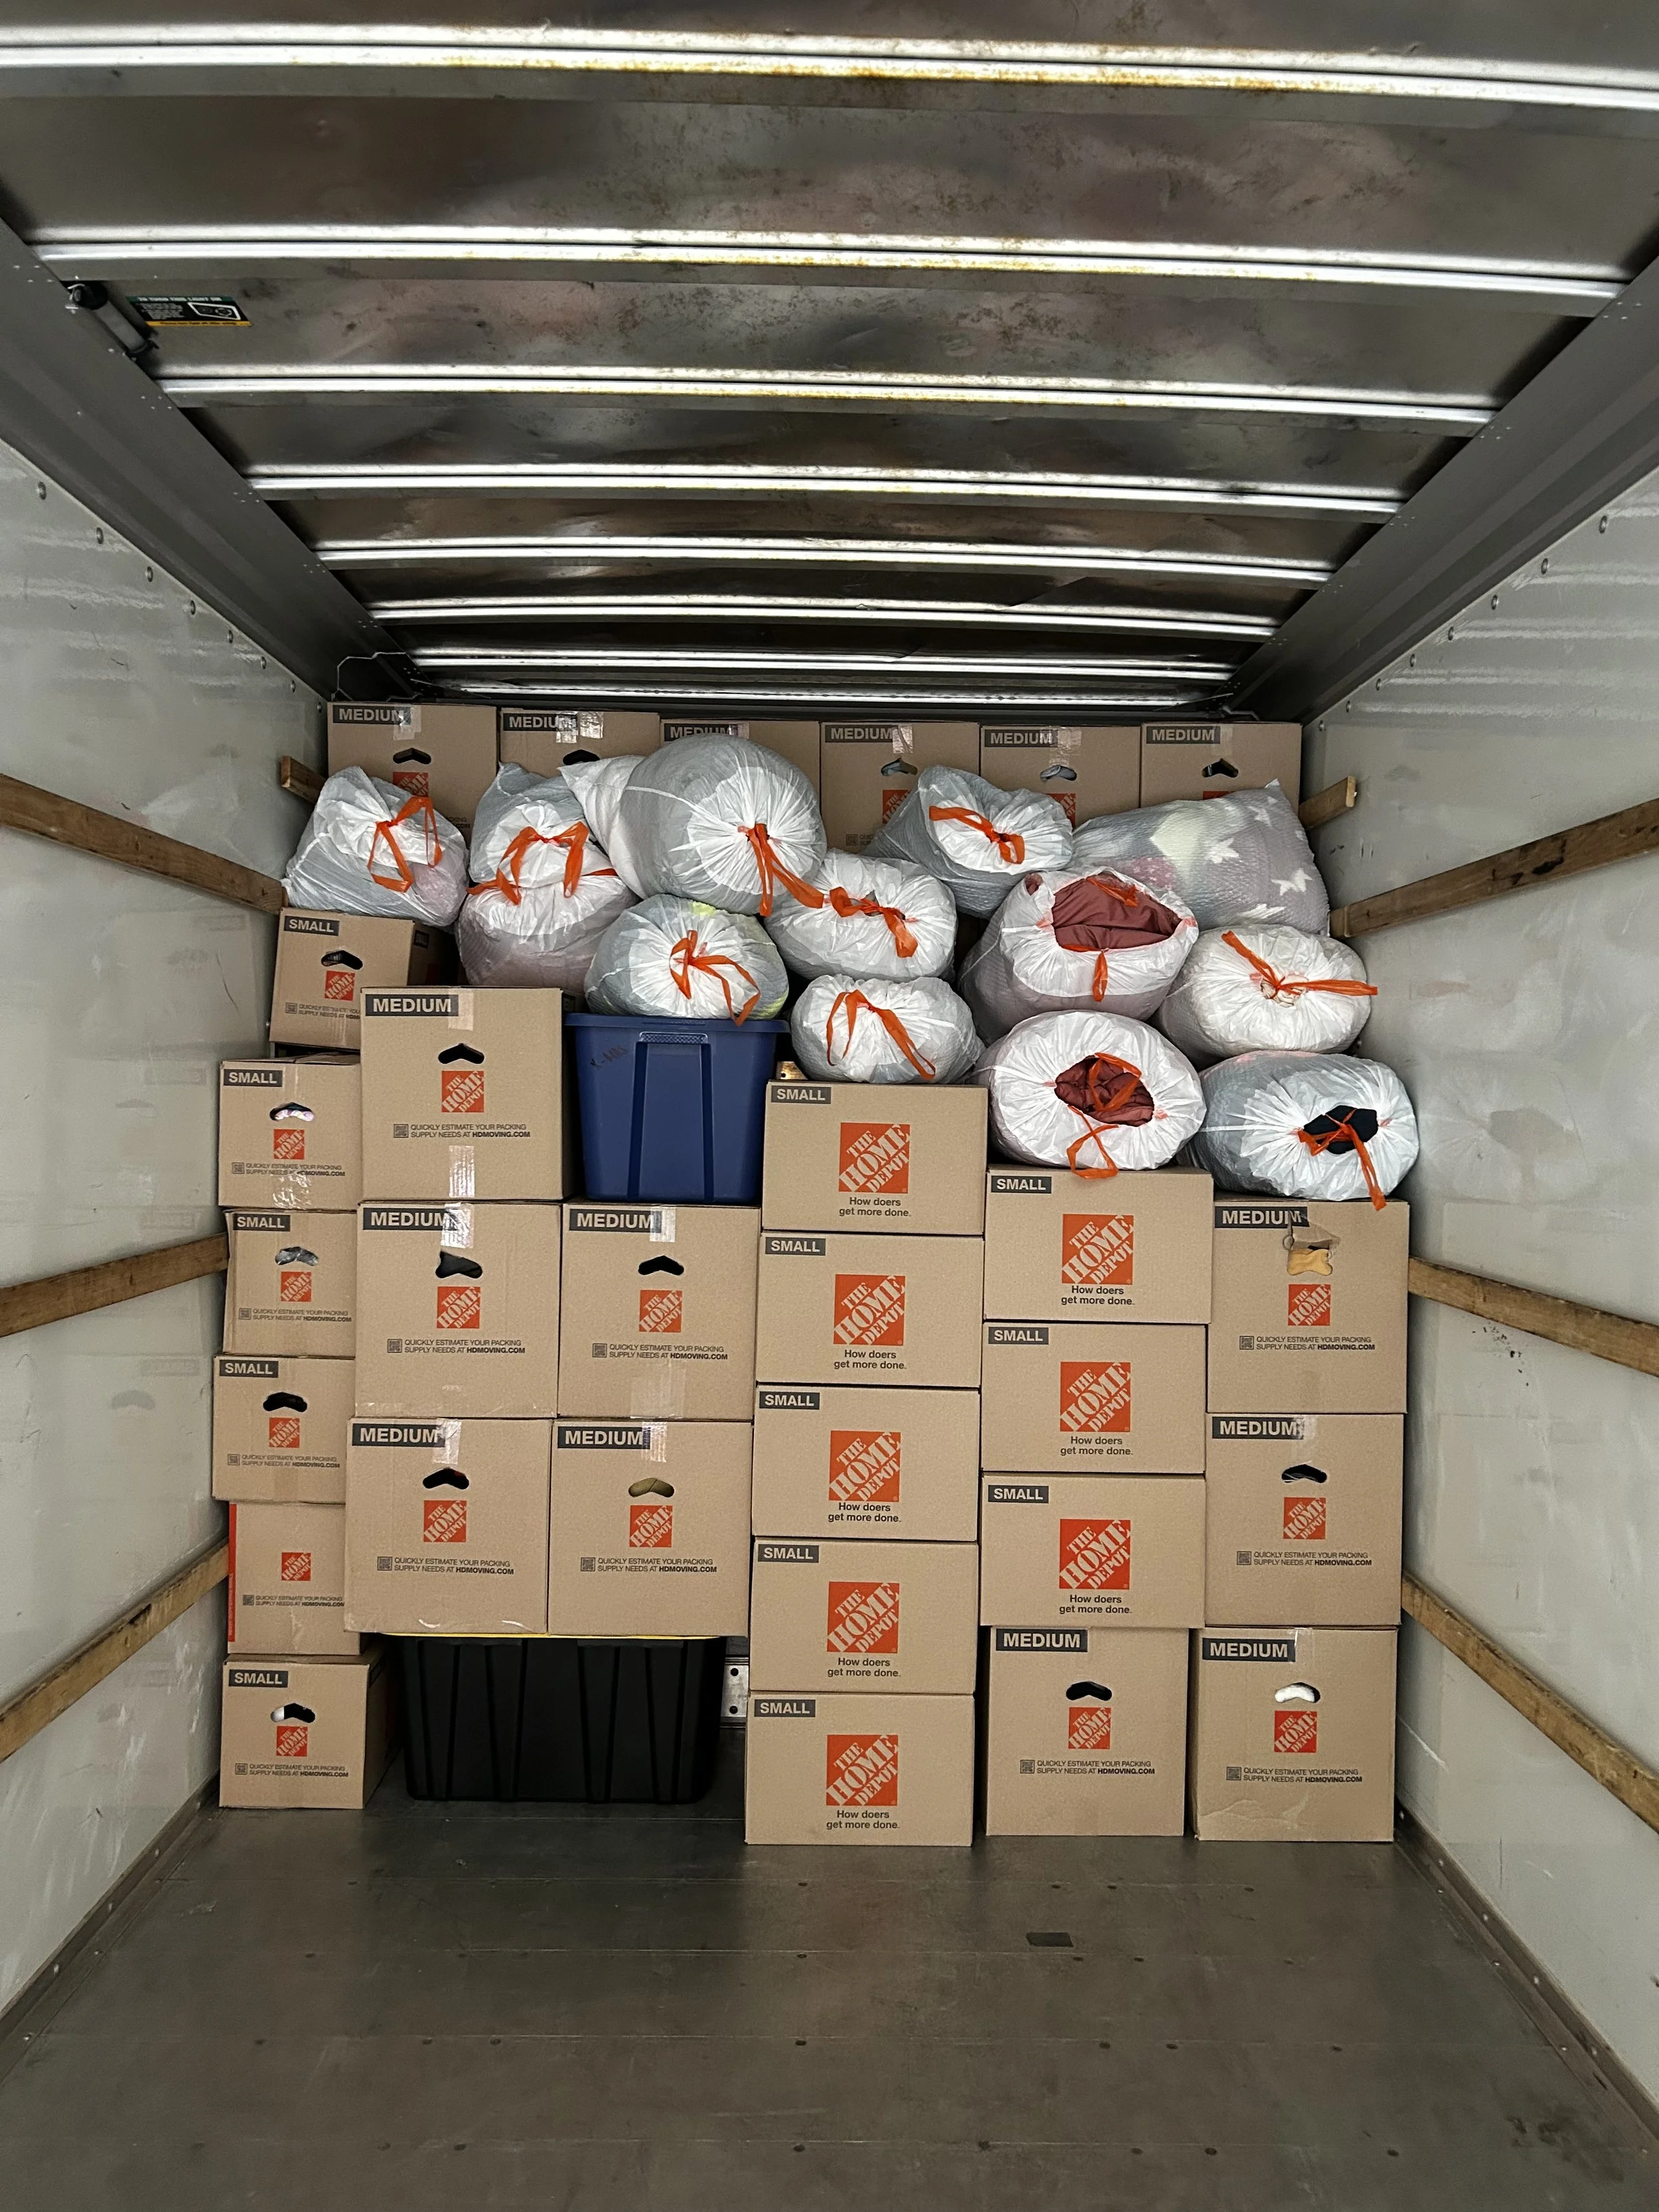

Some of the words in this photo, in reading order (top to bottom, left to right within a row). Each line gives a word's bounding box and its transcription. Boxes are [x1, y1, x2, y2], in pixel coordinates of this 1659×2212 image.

[831, 728, 893, 740] MEDIUM
[990, 733, 1052, 745] MEDIUM
[1152, 729, 1214, 741] MEDIUM
[289, 919, 334, 932] SMALL
[373, 998, 451, 1012] MEDIUM
[228, 1072, 277, 1084] SMALL
[447, 1076, 464, 1091] THE
[442, 1072, 484, 1112] HOME
[458, 1087, 483, 1112] DEPOT
[776, 1088, 826, 1101] SMALL
[847, 1131, 876, 1157] THE
[839, 1124, 910, 1192] HOME
[866, 1149, 908, 1192] DEPOT
[997, 1179, 1046, 1191] SMALL
[849, 1197, 871, 1206] How
[873, 1197, 901, 1207] doers
[839, 1207, 855, 1217] get
[1222, 1210, 1302, 1224] MEDIUM
[236, 1216, 285, 1228] SMALL
[577, 1213, 654, 1228] MEDIUM
[1070, 1222, 1099, 1248] THE
[770, 1240, 820, 1252] SMALL
[1062, 1215, 1133, 1284] HOME
[1089, 1241, 1132, 1284] DEPOT
[281, 1272, 311, 1301] HOME
[284, 1275, 297, 1286] THE
[292, 1283, 311, 1301] DEPOT
[841, 1282, 871, 1309] THE
[1071, 1286, 1094, 1294] How
[1096, 1286, 1124, 1295] doers
[1293, 1289, 1310, 1305] THE
[442, 1291, 460, 1307] THE
[644, 1295, 662, 1311] THE
[1061, 1296, 1077, 1306] get
[1288, 1285, 1331, 1325] HOME
[437, 1288, 480, 1328] HOME
[454, 1303, 480, 1328] DEPOT
[640, 1291, 682, 1332] HOME
[833, 1275, 905, 1345] HOME
[1304, 1300, 1330, 1325] DEPOT
[656, 1306, 681, 1332] DEPOT
[861, 1301, 904, 1345] DEPOT
[993, 1330, 1043, 1342] SMALL
[844, 1349, 866, 1359] How
[869, 1350, 897, 1359] doers
[225, 1363, 273, 1375] SMALL
[834, 1361, 850, 1370] get
[1068, 1370, 1097, 1396] THE
[764, 1394, 814, 1406] SMALL
[1060, 1363, 1130, 1431] HOME
[1087, 1388, 1129, 1431] DEPOT
[360, 1427, 438, 1443] MEDIUM
[1220, 1421, 1297, 1435] MEDIUM
[565, 1430, 642, 1445] MEDIUM
[1095, 1436, 1123, 1445] doers
[837, 1439, 867, 1465] THE
[1060, 1447, 1077, 1456] get
[830, 1432, 901, 1501] HOME
[857, 1458, 899, 1501] DEPOT
[993, 1487, 1043, 1500] SMALL
[428, 1505, 446, 1521] THE
[839, 1503, 860, 1511] How
[863, 1503, 891, 1512] doers
[1288, 1502, 1305, 1518] THE
[423, 1501, 467, 1542] HOME
[634, 1510, 652, 1526] THE
[828, 1513, 845, 1522] get
[1283, 1498, 1325, 1539] HOME
[440, 1516, 466, 1542] DEPOT
[630, 1506, 672, 1547] HOME
[646, 1521, 672, 1547] DEPOT
[1299, 1513, 1325, 1539] DEPOT
[1067, 1527, 1096, 1554] THE
[763, 1547, 814, 1560] SMALL
[1059, 1520, 1131, 1588] HOME
[1086, 1546, 1129, 1588] DEPOT
[835, 1589, 865, 1617] THE
[1070, 1594, 1092, 1603] How
[1094, 1595, 1121, 1603] doers
[827, 1582, 899, 1652] HOME
[1059, 1605, 1076, 1614] get
[854, 1609, 898, 1652] DEPOT
[1003, 1633, 1080, 1648] MEDIUM
[1210, 1643, 1288, 1657] MEDIUM
[838, 1657, 860, 1666] How
[863, 1658, 891, 1666] doers
[234, 1672, 283, 1686] SMALL
[828, 1668, 843, 1677] get
[760, 1702, 810, 1715] SMALL
[1068, 1708, 1111, 1748] HOME
[1073, 1712, 1090, 1728] THE
[1279, 1716, 1296, 1732] THE
[279, 1730, 292, 1741] THE
[1084, 1723, 1110, 1748] DEPOT
[1274, 1712, 1317, 1752] HOME
[1290, 1727, 1316, 1752] DEPOT
[276, 1726, 307, 1756] HOME
[288, 1737, 307, 1756] DEPOT
[834, 1743, 863, 1769] THE
[826, 1735, 898, 1805] HOME
[853, 1762, 897, 1805] DEPOT
[837, 1810, 859, 1818] How
[826, 1821, 842, 1830] get
